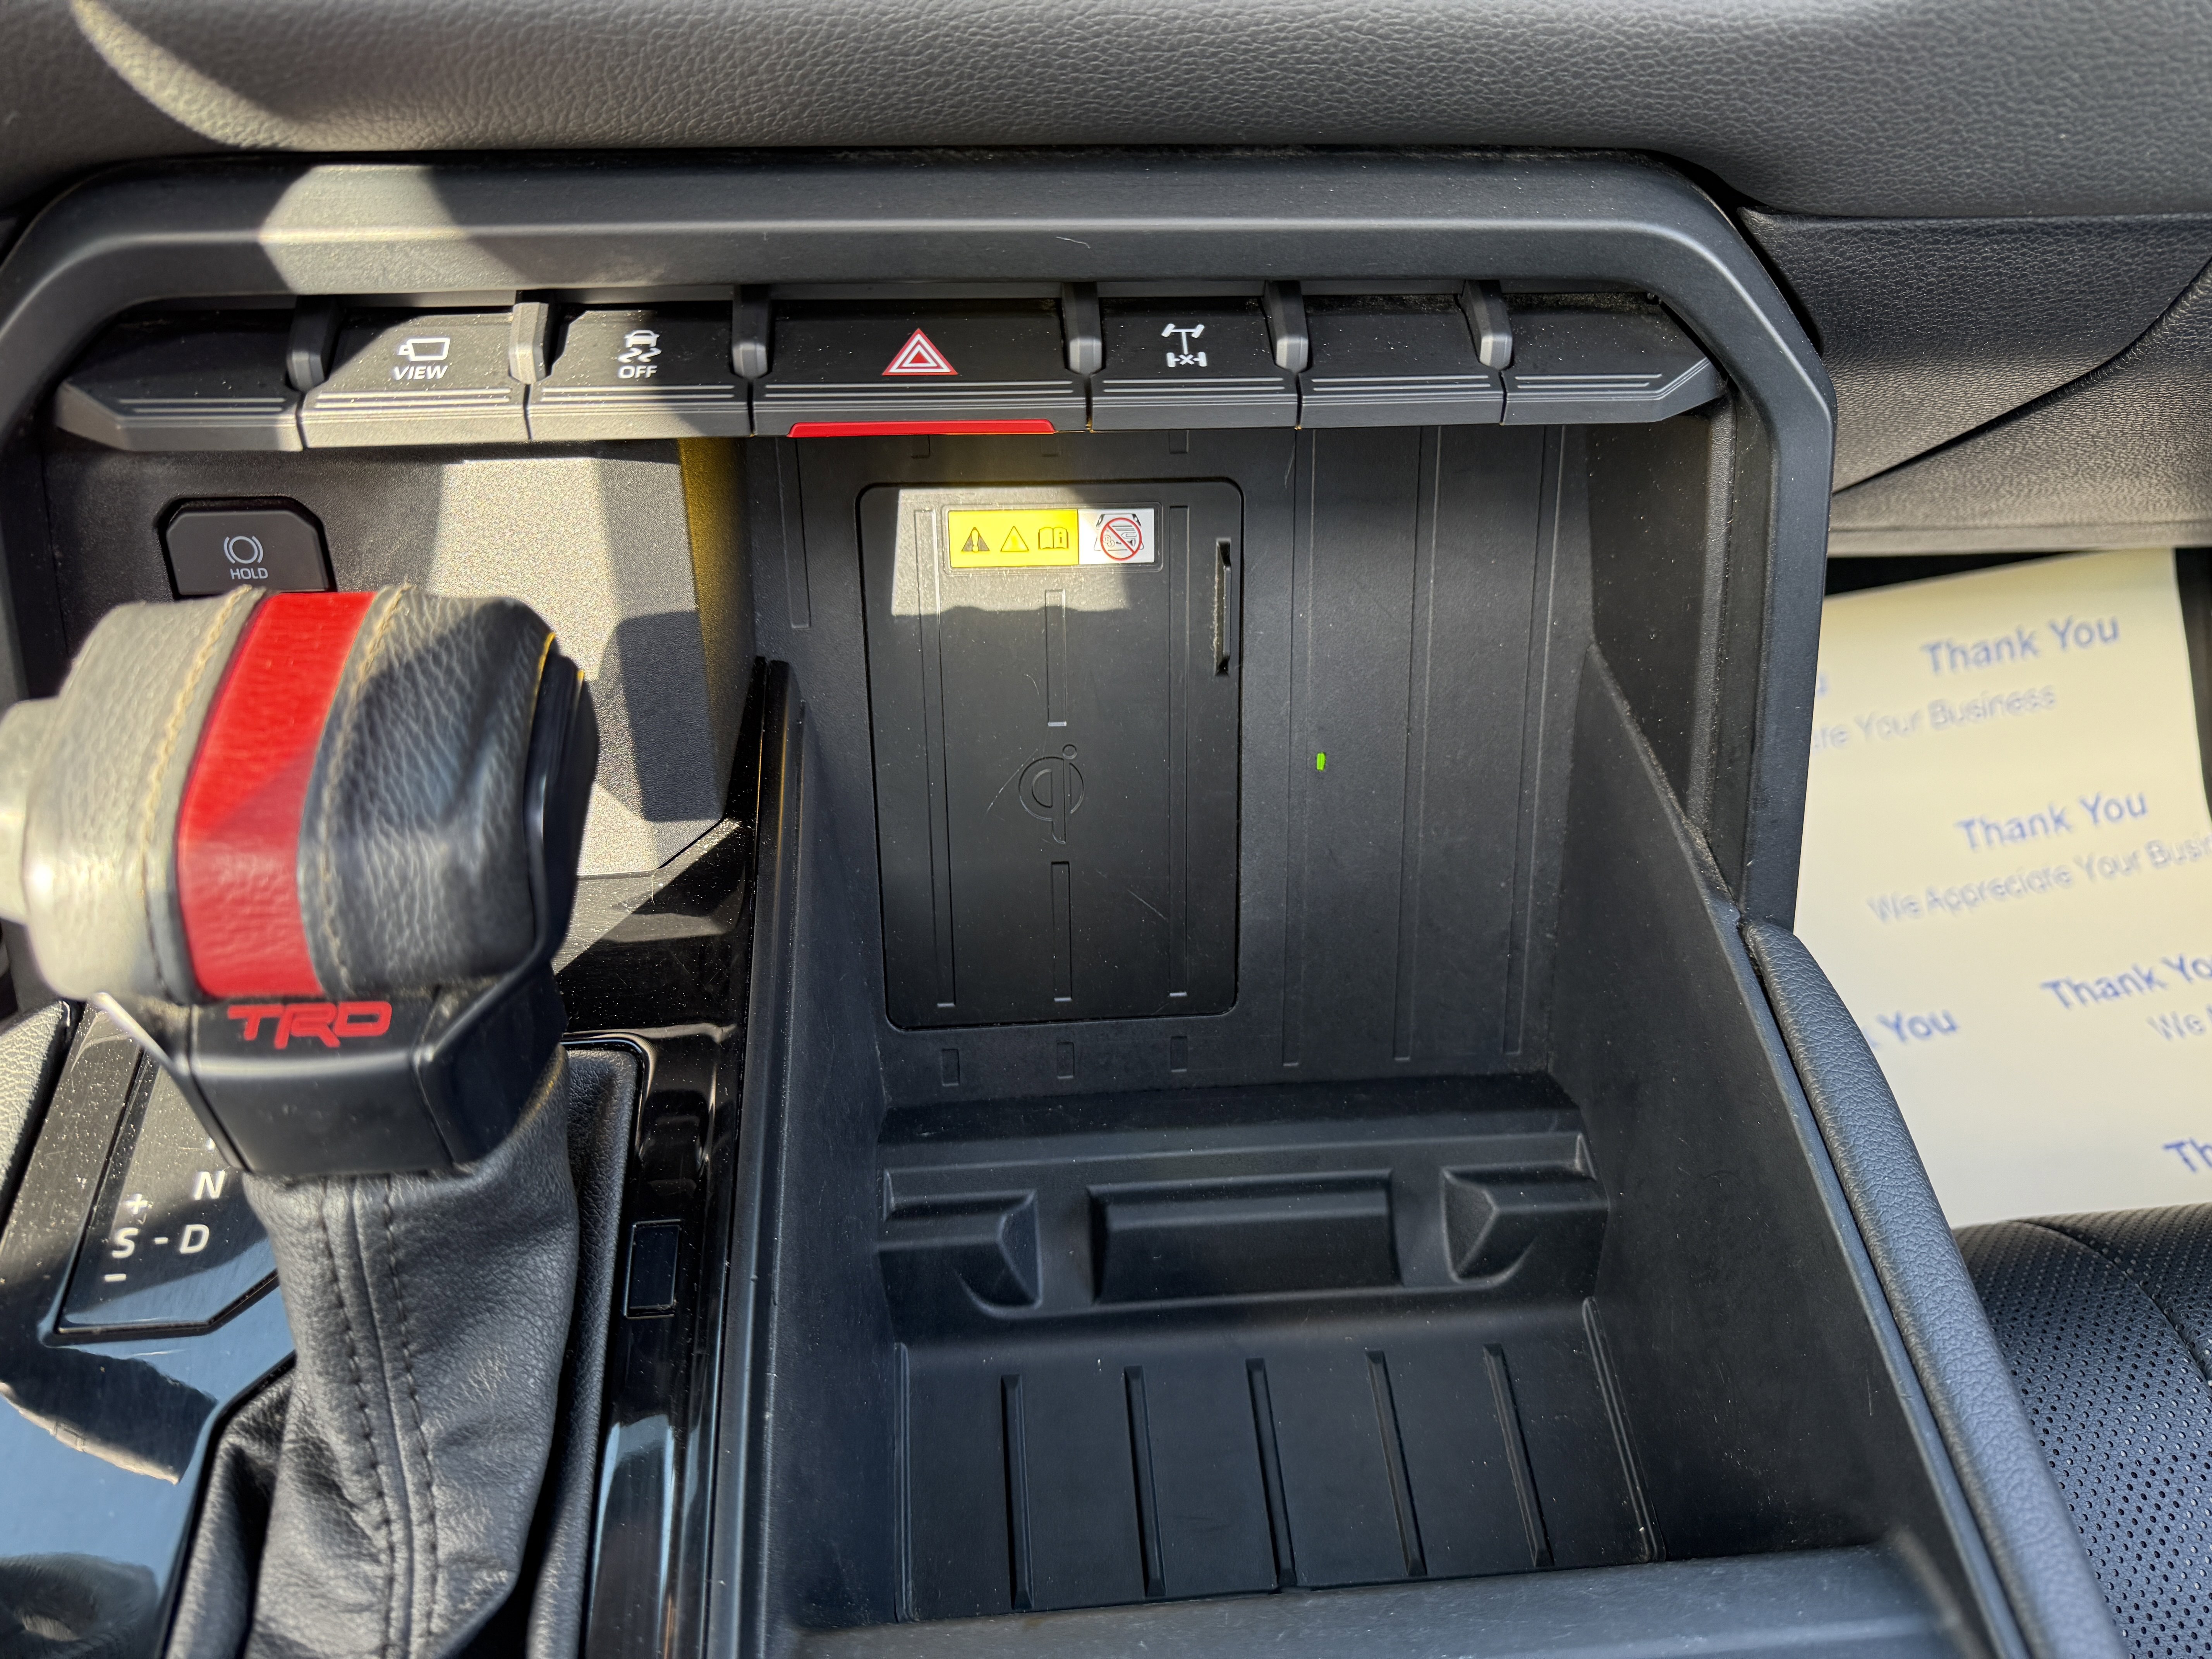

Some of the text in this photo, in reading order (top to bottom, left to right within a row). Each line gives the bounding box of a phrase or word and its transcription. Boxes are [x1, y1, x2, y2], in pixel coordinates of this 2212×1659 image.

[393, 365, 448, 380] VIEW
[618, 365, 657, 379] OFF
[230, 568, 268, 580] HOLD
[1922, 616, 2119, 673] Thank You
[1853, 710, 1922, 742] Your
[1929, 685, 2056, 731] Business
[1956, 792, 2147, 850] Thank You
[1867, 891, 1923, 923] We
[1925, 864, 2074, 917] Appreciate
[2072, 850, 2142, 882] Your
[2039, 962, 2169, 1009] Thank
[227, 1000, 392, 1049] TRD
[1876, 1009, 1958, 1043] You
[2145, 1010, 2206, 1041] We
[194, 1170, 225, 1200] N
[112, 1227, 139, 1259] S
[180, 1224, 210, 1254] D
